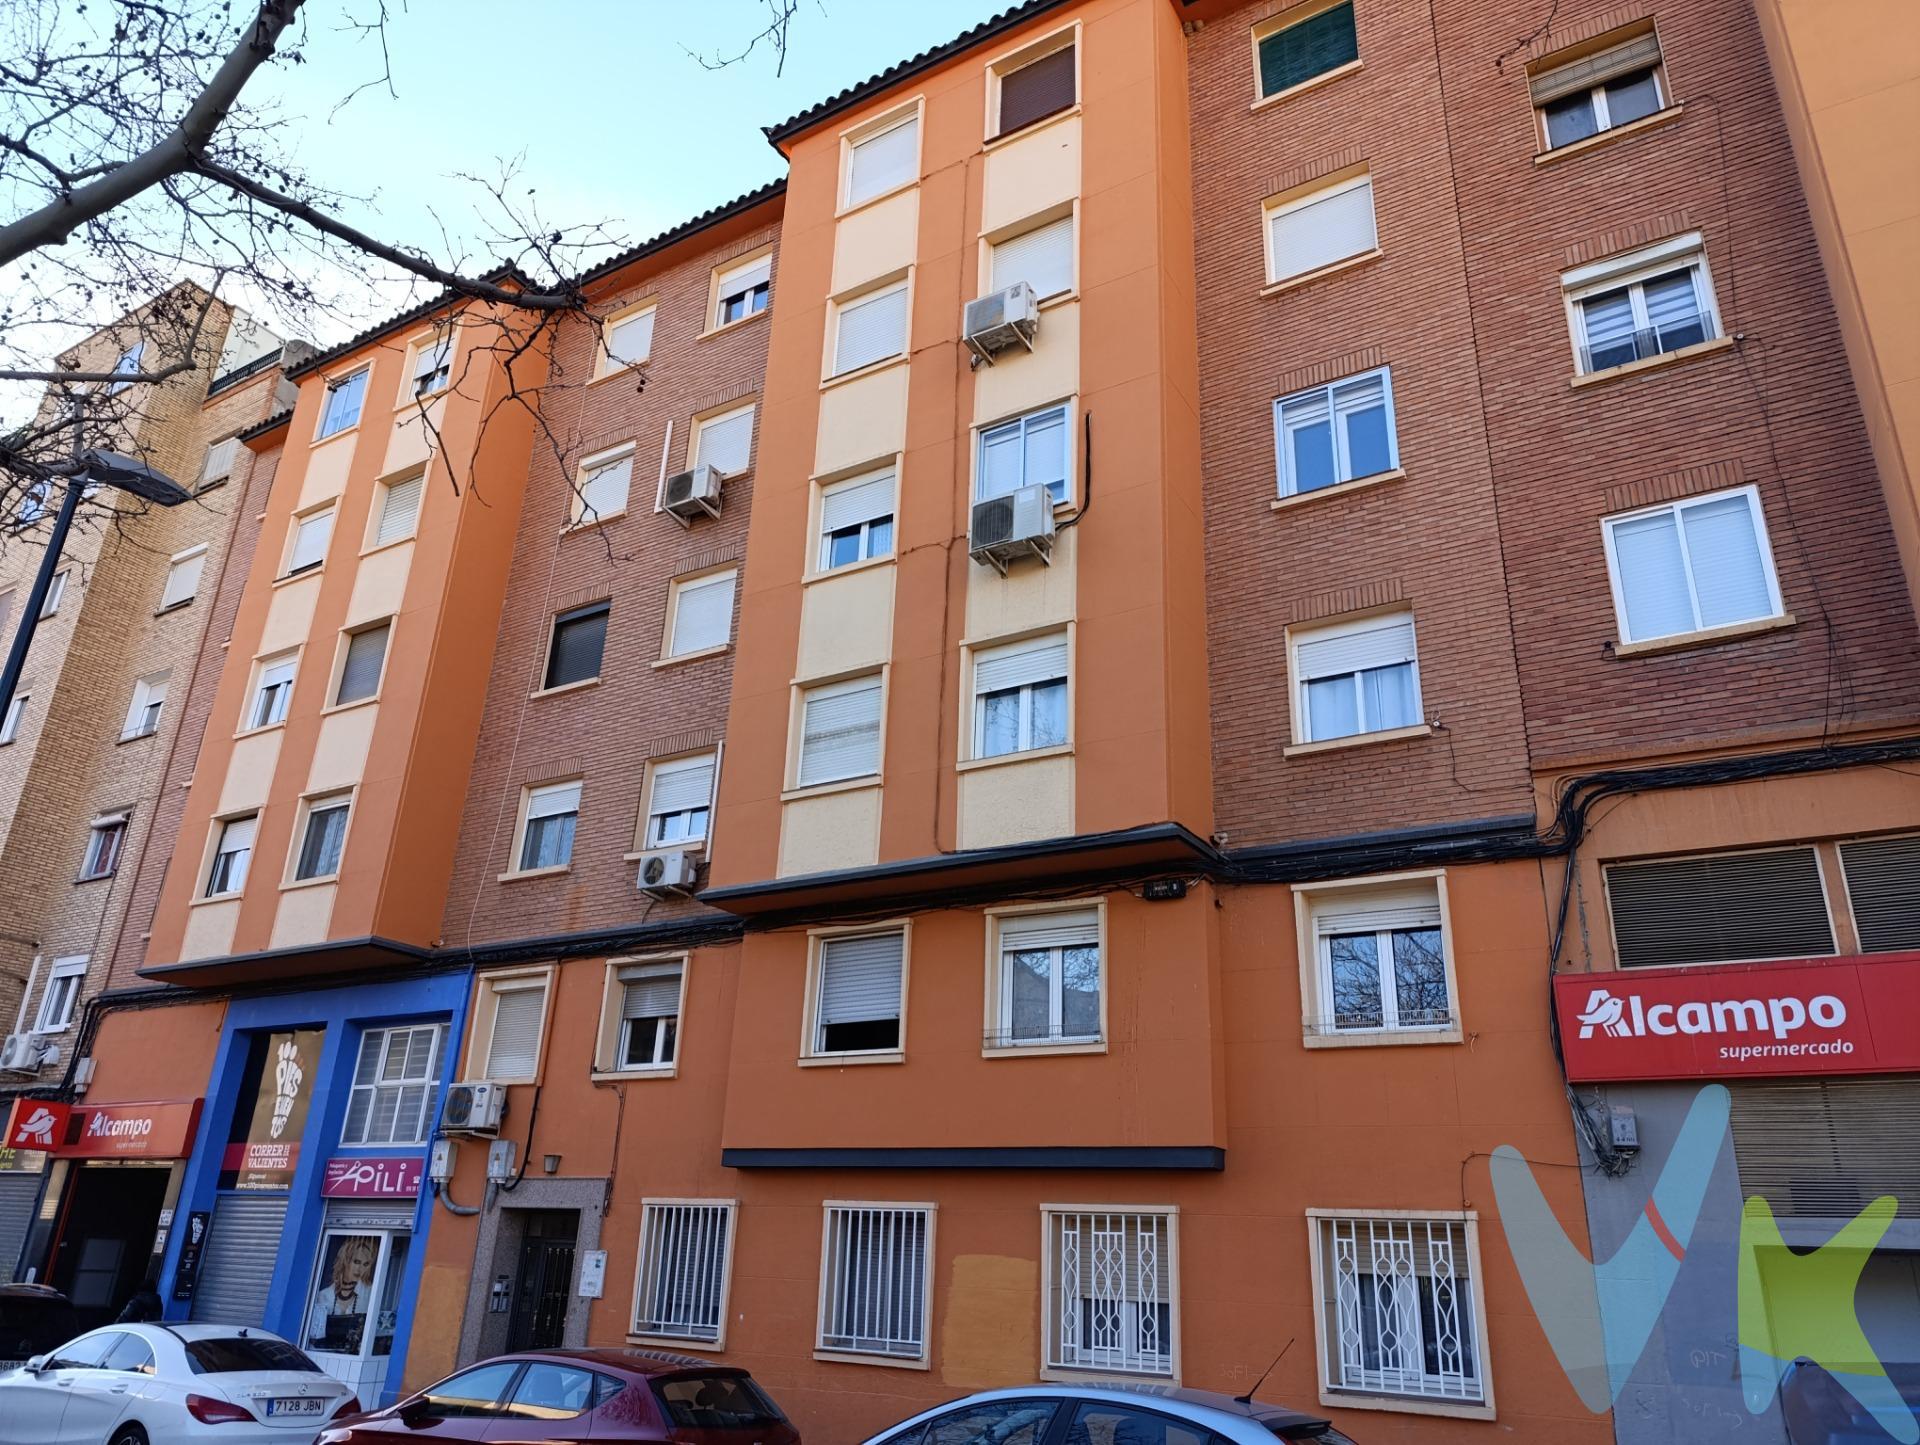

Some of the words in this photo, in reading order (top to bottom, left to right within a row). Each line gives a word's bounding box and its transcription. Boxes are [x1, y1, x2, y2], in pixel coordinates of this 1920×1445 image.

[1576, 988, 1847, 1040] Alcampo
[1719, 1038, 1854, 1062] supermercado
[87, 1111, 152, 1139] Alcampo
[250, 1144, 284, 1157] CORRER
[248, 1157, 288, 1169] VALIENTES
[275, 1401, 300, 1412] 7128
[303, 1401, 321, 1411] JBN
